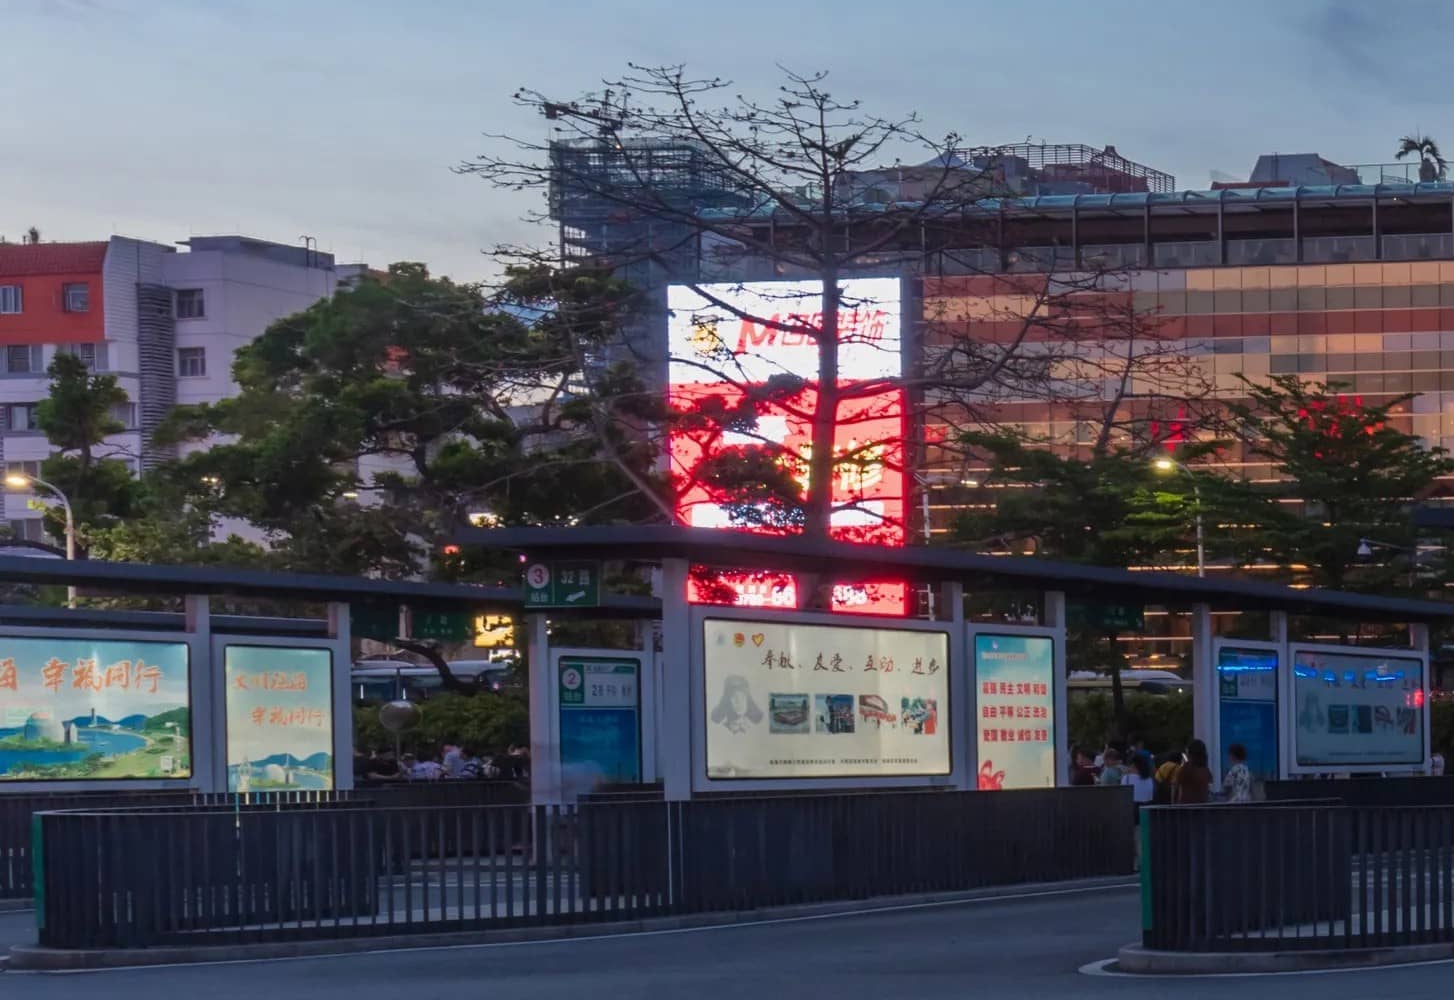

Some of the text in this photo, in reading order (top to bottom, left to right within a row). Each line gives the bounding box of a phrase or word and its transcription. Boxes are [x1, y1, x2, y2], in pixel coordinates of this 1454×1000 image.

[534, 567, 544, 585] 3
[42, 657, 162, 693] 幸福同行
[567, 672, 578, 685] 2
